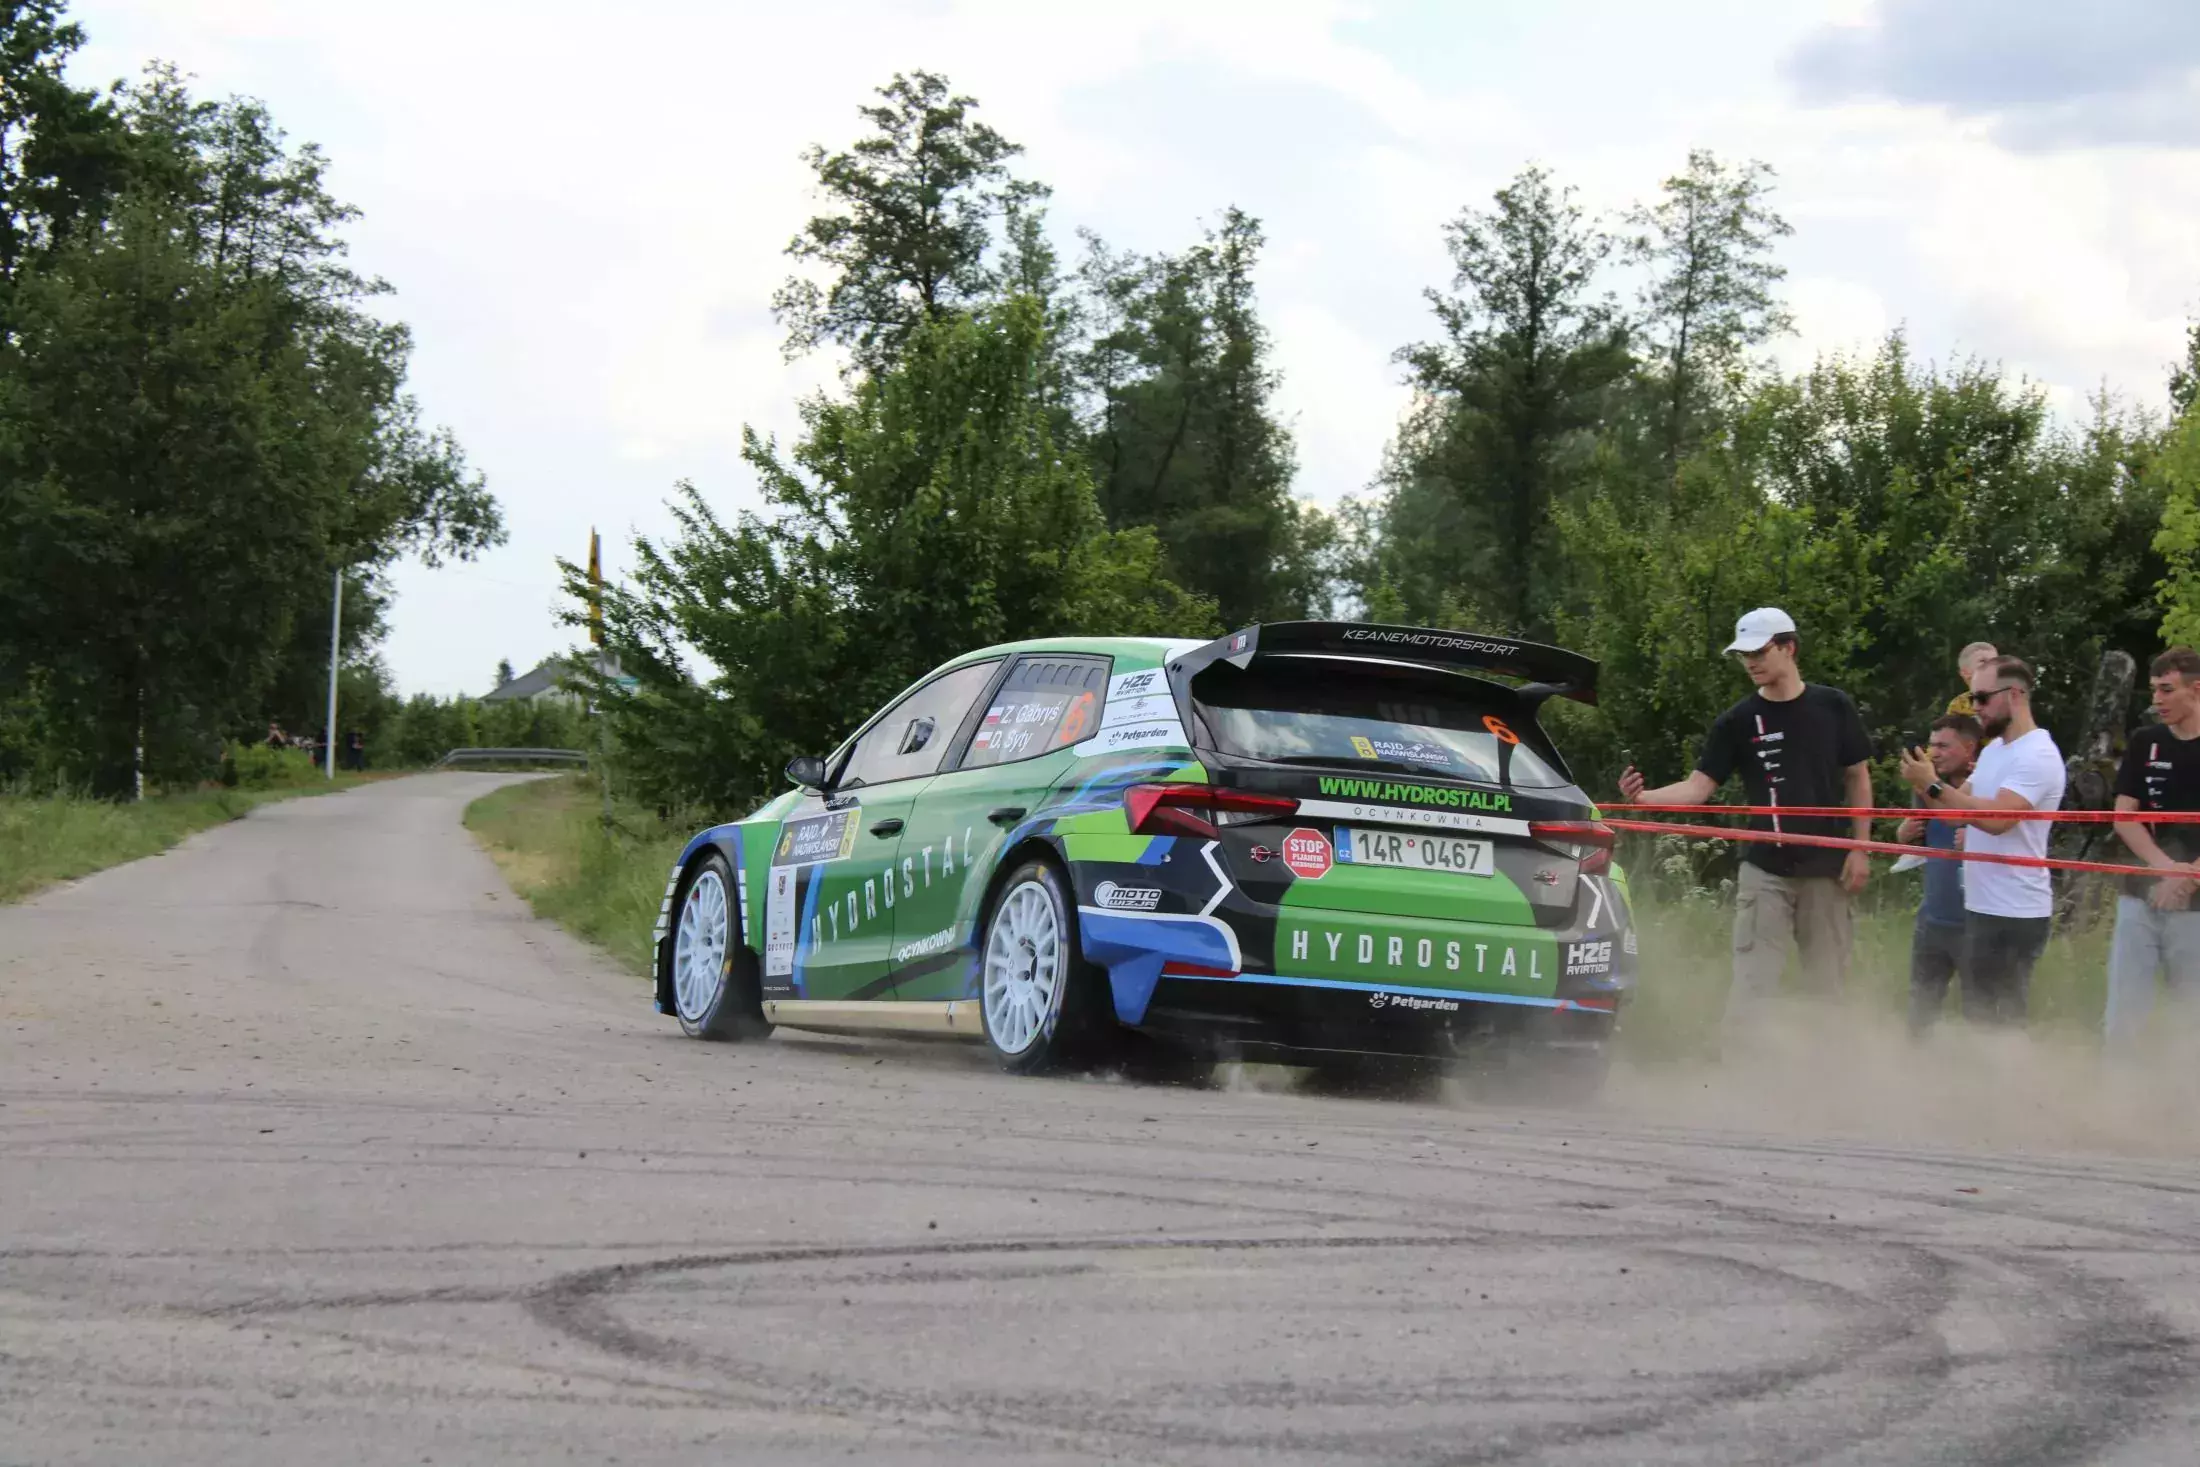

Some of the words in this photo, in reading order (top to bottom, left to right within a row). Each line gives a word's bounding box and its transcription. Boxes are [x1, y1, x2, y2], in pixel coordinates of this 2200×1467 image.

[1119, 673, 1157, 690] HZG
[1000, 706, 1012, 724] Z.
[1060, 691, 1094, 743] 6
[989, 731, 1003, 747] D.
[1481, 715, 1520, 745] 6
[1373, 740, 1404, 750] RAJD
[1319, 776, 1512, 812] WWW.HYDROSTAL.PL
[1354, 807, 1482, 827] OCYNKOWNIA
[797, 823, 820, 843] RAJD
[780, 831, 793, 857] 6
[1290, 838, 1325, 853] STOP
[1358, 833, 1403, 863] 14R
[1422, 839, 1481, 870] 0467
[1339, 850, 1351, 859] CZ
[811, 826, 973, 956] HYDROSTAL
[1111, 889, 1160, 899] MOTO
[1108, 898, 1157, 908] WIZJA
[1292, 930, 1542, 979] HYDROSTAL
[1567, 941, 1612, 965] HZG
[1566, 963, 1609, 976] AVIATION
[1391, 995, 1459, 1011] Petgarden
